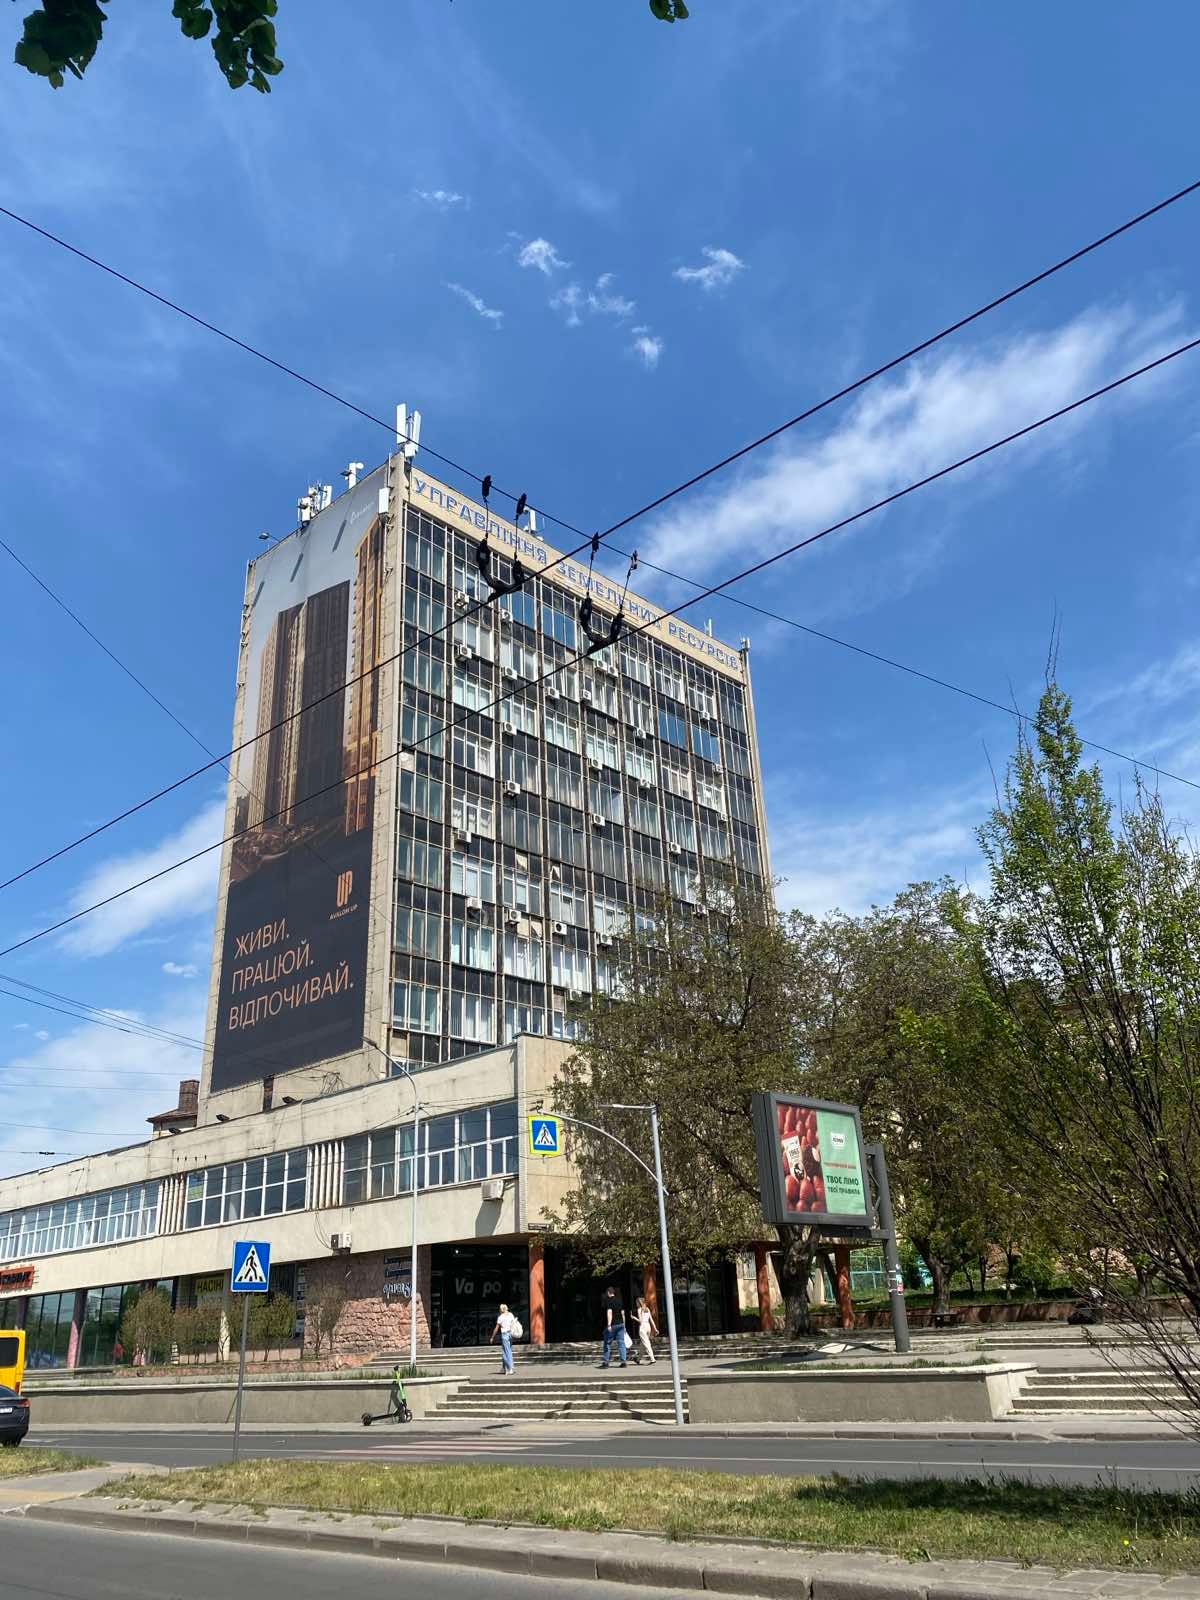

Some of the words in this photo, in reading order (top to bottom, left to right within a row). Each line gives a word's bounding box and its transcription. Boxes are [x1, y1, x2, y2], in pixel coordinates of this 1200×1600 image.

[414, 477, 548, 565] УПРАВЛІННЯ
[668, 621, 738, 670] РЕСУРСІВ
[231, 938, 314, 994] ПРАЦЮЙ.
[233, 918, 290, 960] ЖИВИ.
[228, 960, 354, 1030] ВІДПОЧИВАЙ.
